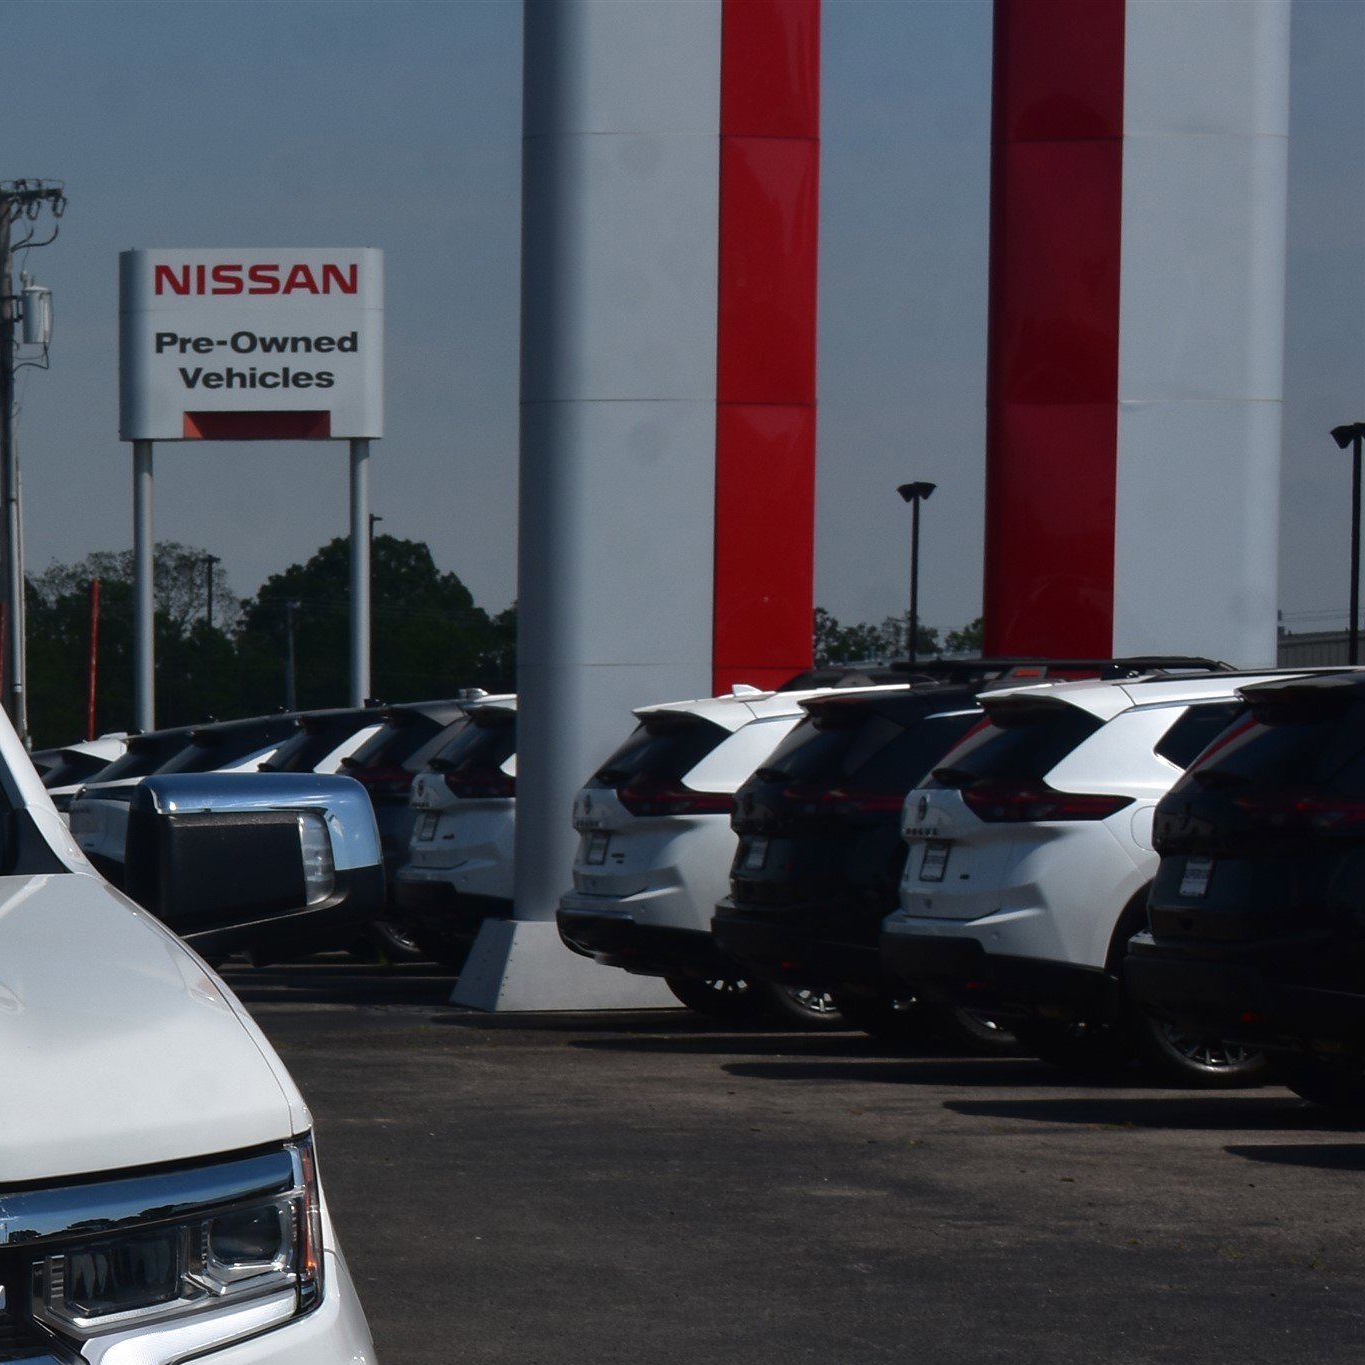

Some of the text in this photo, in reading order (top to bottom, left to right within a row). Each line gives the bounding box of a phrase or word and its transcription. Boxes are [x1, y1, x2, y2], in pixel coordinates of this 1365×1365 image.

[155, 264, 358, 296] NISSAN
[155, 331, 358, 354] Pre-Owned
[178, 366, 335, 390] Vehicles
